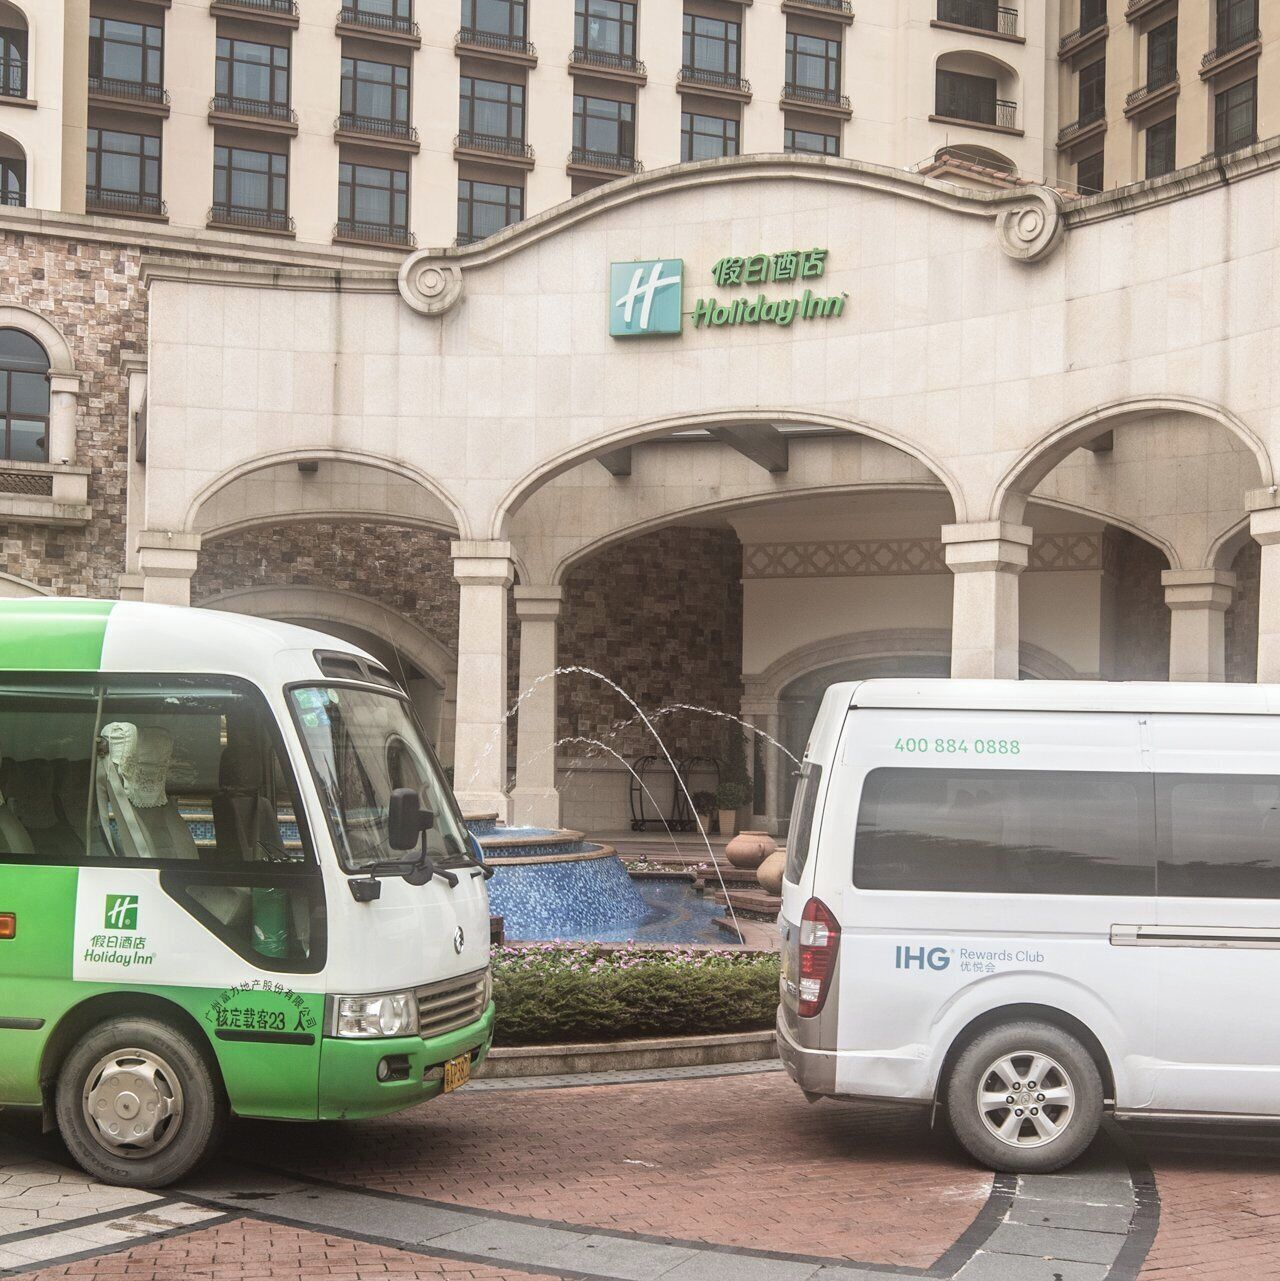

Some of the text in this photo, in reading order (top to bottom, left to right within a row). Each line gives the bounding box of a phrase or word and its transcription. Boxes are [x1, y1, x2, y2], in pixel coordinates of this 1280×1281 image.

[711, 247, 828, 288] 假日酒店
[691, 288, 844, 328] Holiday Inn
[894, 738, 1020, 755] 400 884 0888
[90, 935, 146, 950] 假日酒店
[84, 948, 154, 967] Holiday Inn
[895, 945, 1045, 971] IHG Rewards Club
[960, 961, 996, 973] 优悦会
[204, 979, 317, 1029] 广州富力地产股份有限公司
